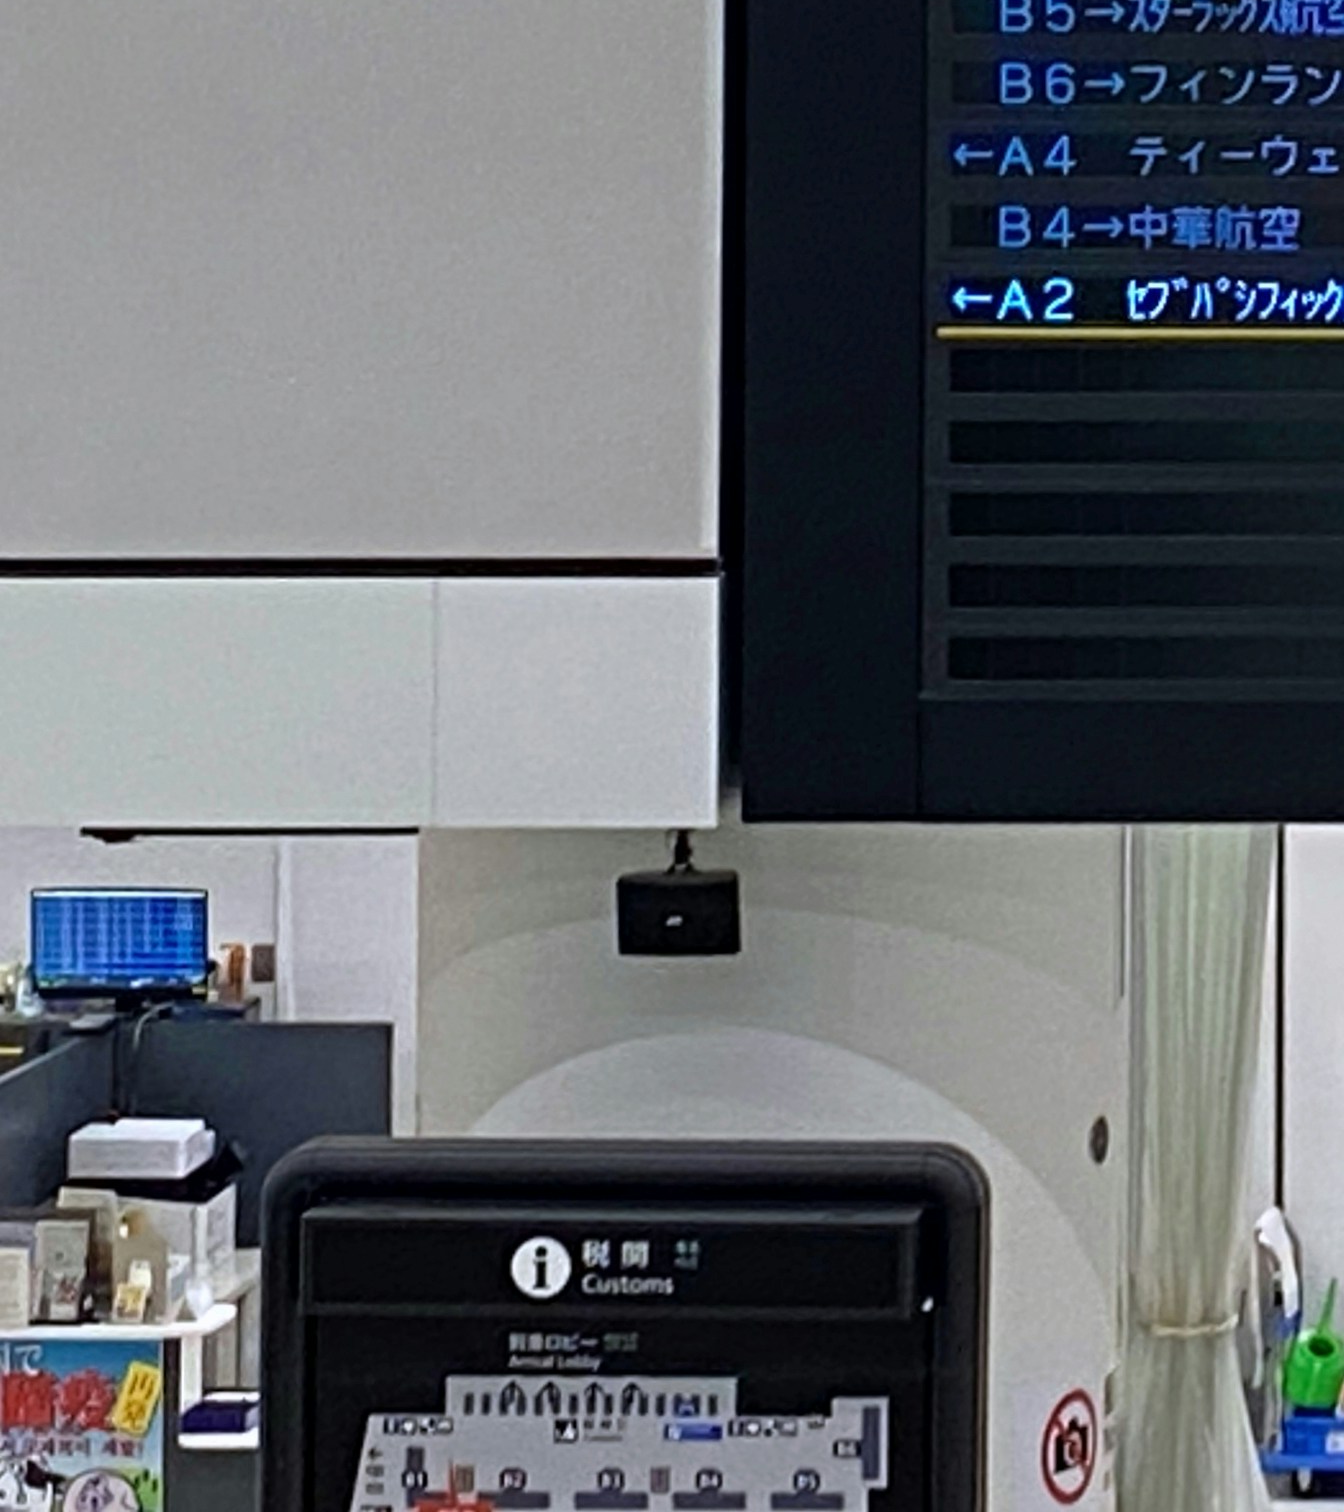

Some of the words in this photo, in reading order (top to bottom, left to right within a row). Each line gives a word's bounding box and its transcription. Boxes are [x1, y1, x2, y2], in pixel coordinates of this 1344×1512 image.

[999, 61, 1076, 105] B6
[998, 133, 1077, 176] A4
[998, 204, 1076, 249] B4
[1127, 203, 1302, 253] 中華航空
[996, 277, 1077, 323] A2
[580, 1273, 675, 1295] Customs
